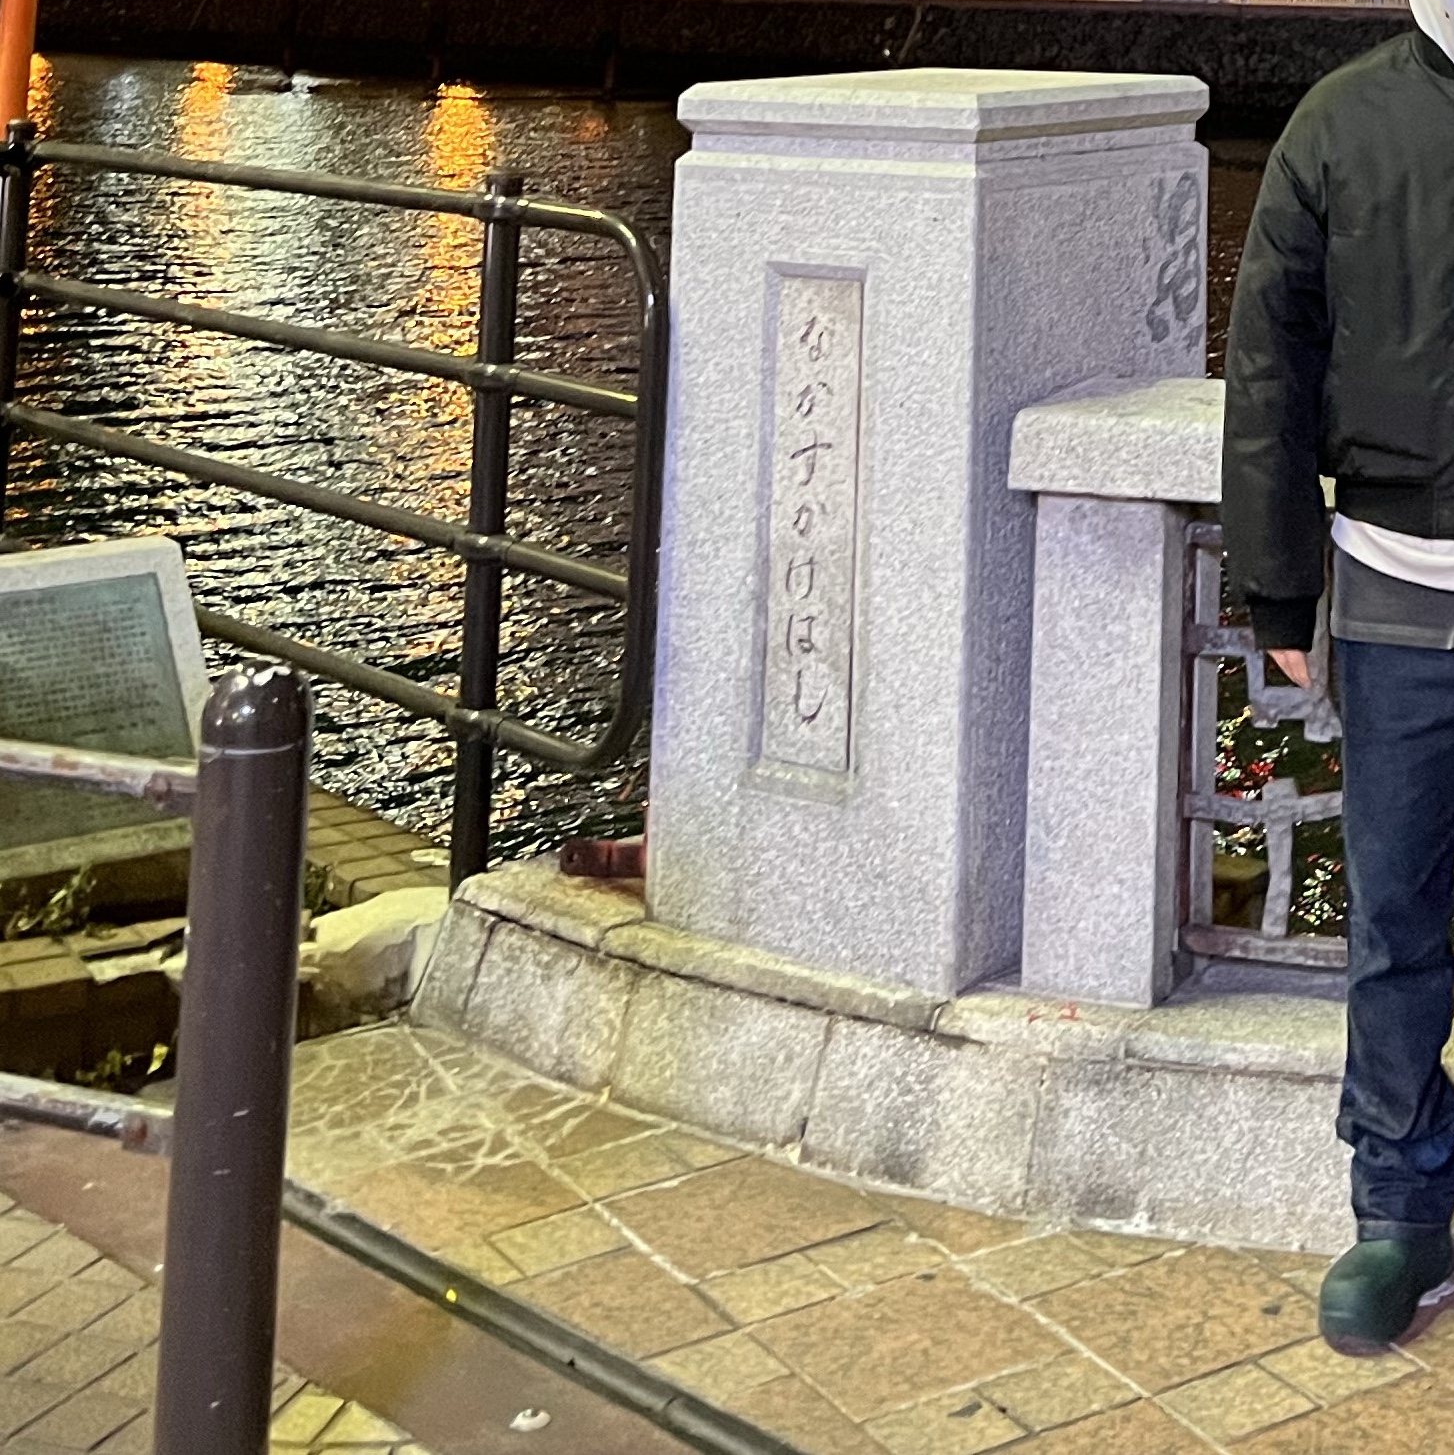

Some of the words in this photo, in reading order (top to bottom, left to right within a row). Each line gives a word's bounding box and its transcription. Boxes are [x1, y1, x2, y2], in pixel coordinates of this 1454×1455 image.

[785, 317, 838, 725] なかすかけはし
